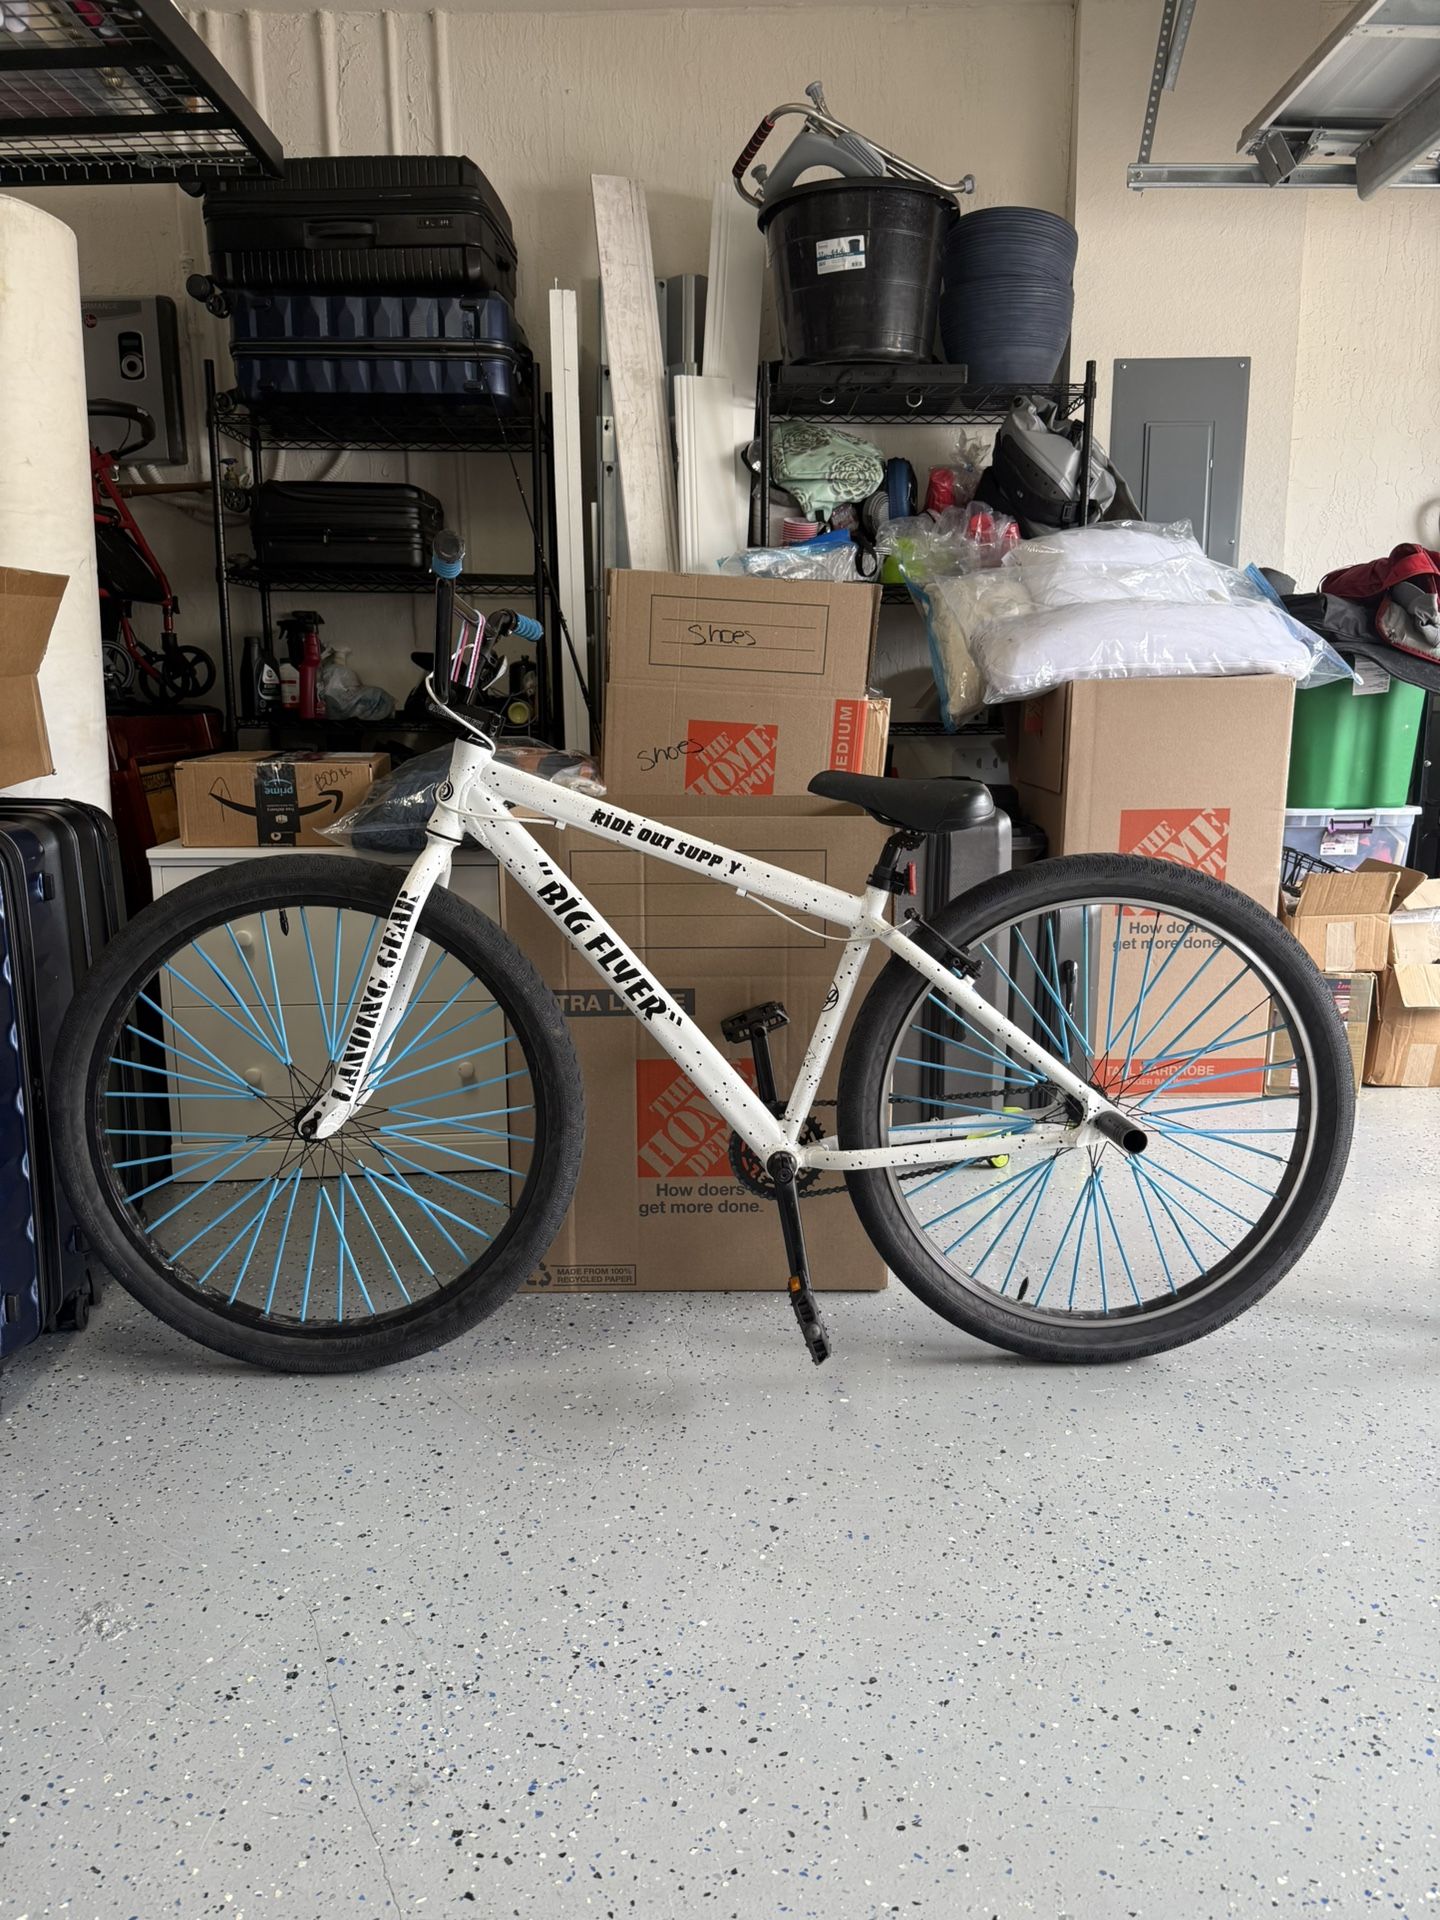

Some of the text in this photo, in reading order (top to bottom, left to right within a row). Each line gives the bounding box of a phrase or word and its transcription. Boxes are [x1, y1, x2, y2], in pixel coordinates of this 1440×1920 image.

[695, 731, 733, 766] THE
[730, 758, 775, 795] EPOT
[264, 786, 294, 797] prime
[590, 809, 635, 836] RIDE
[637, 828, 675, 850] OUT
[1129, 922, 1162, 934] How
[331, 890, 421, 1102] LANDING GEAR
[553, 993, 602, 1012] TRA
[656, 1183, 746, 1197] How doers
[638, 1201, 666, 1217] get
[670, 1203, 713, 1214] more
[611, 1267, 632, 1275] 100%
[557, 1275, 632, 1284] RECYCLED PAPER
